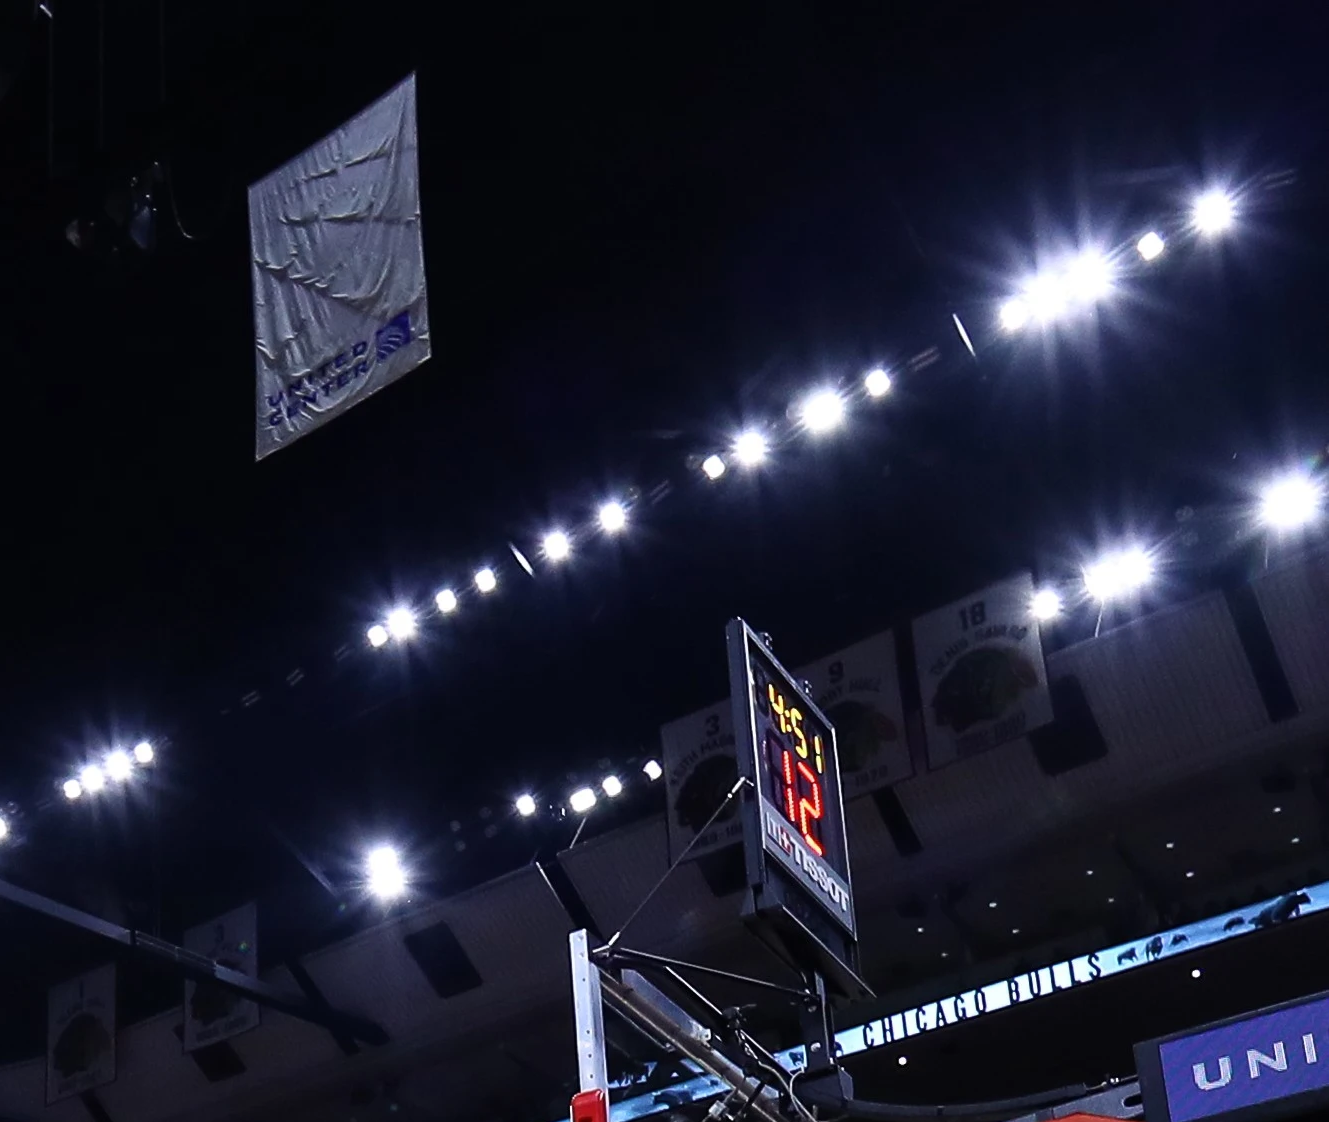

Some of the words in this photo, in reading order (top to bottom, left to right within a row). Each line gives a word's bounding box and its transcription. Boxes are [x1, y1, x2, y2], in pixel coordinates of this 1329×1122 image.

[268, 339, 368, 409] UNITED
[268, 359, 370, 428] CENTER
[767, 682, 825, 775] 4:51
[783, 749, 824, 858] 12
[793, 841, 851, 912] TISSOT
[862, 988, 988, 1049] CHICAGO
[1007, 953, 1102, 1004] BULLS
[1191, 1032, 1319, 1092] UNI
